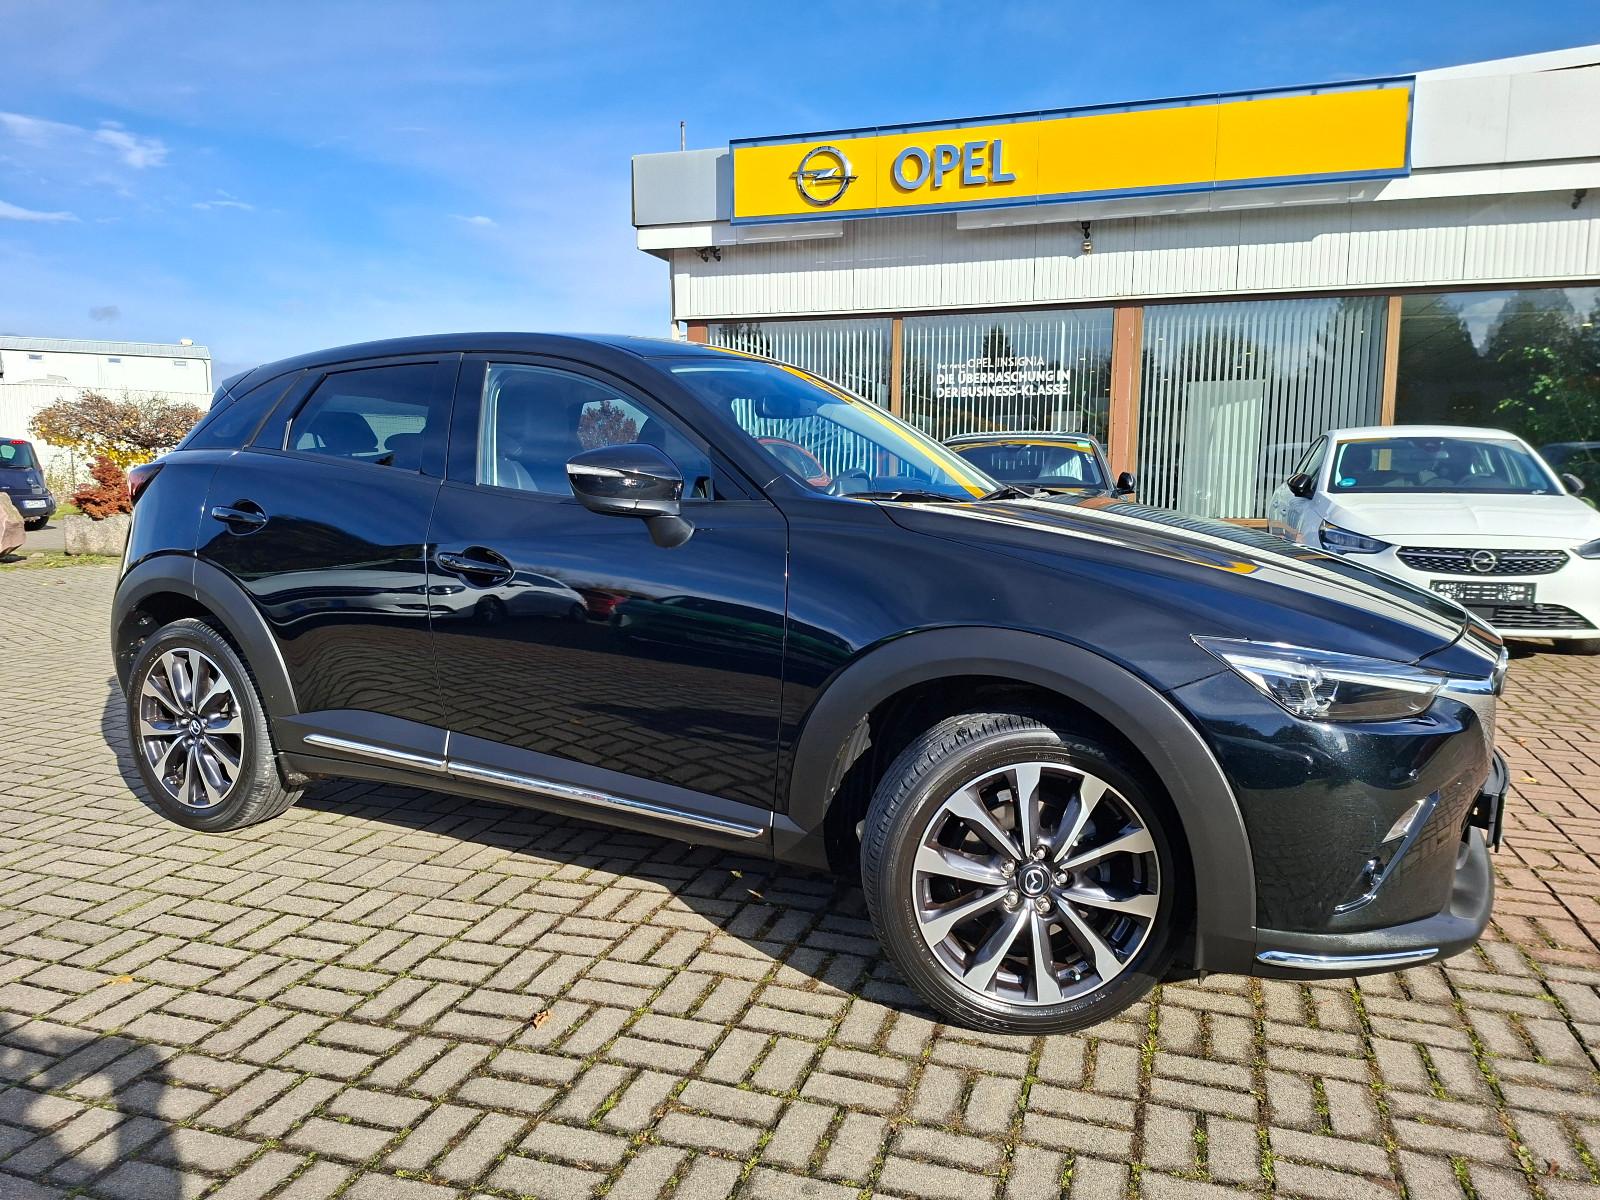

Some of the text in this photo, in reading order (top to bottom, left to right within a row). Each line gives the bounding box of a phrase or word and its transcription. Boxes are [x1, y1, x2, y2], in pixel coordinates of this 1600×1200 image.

[893, 139, 1016, 190] OPEL
[968, 357, 994, 368] OPEL
[997, 356, 1045, 367] INSIGNIA
[937, 370, 1070, 385] DIE ÜBERRASCHUNG IN
[937, 387, 958, 398] DER
